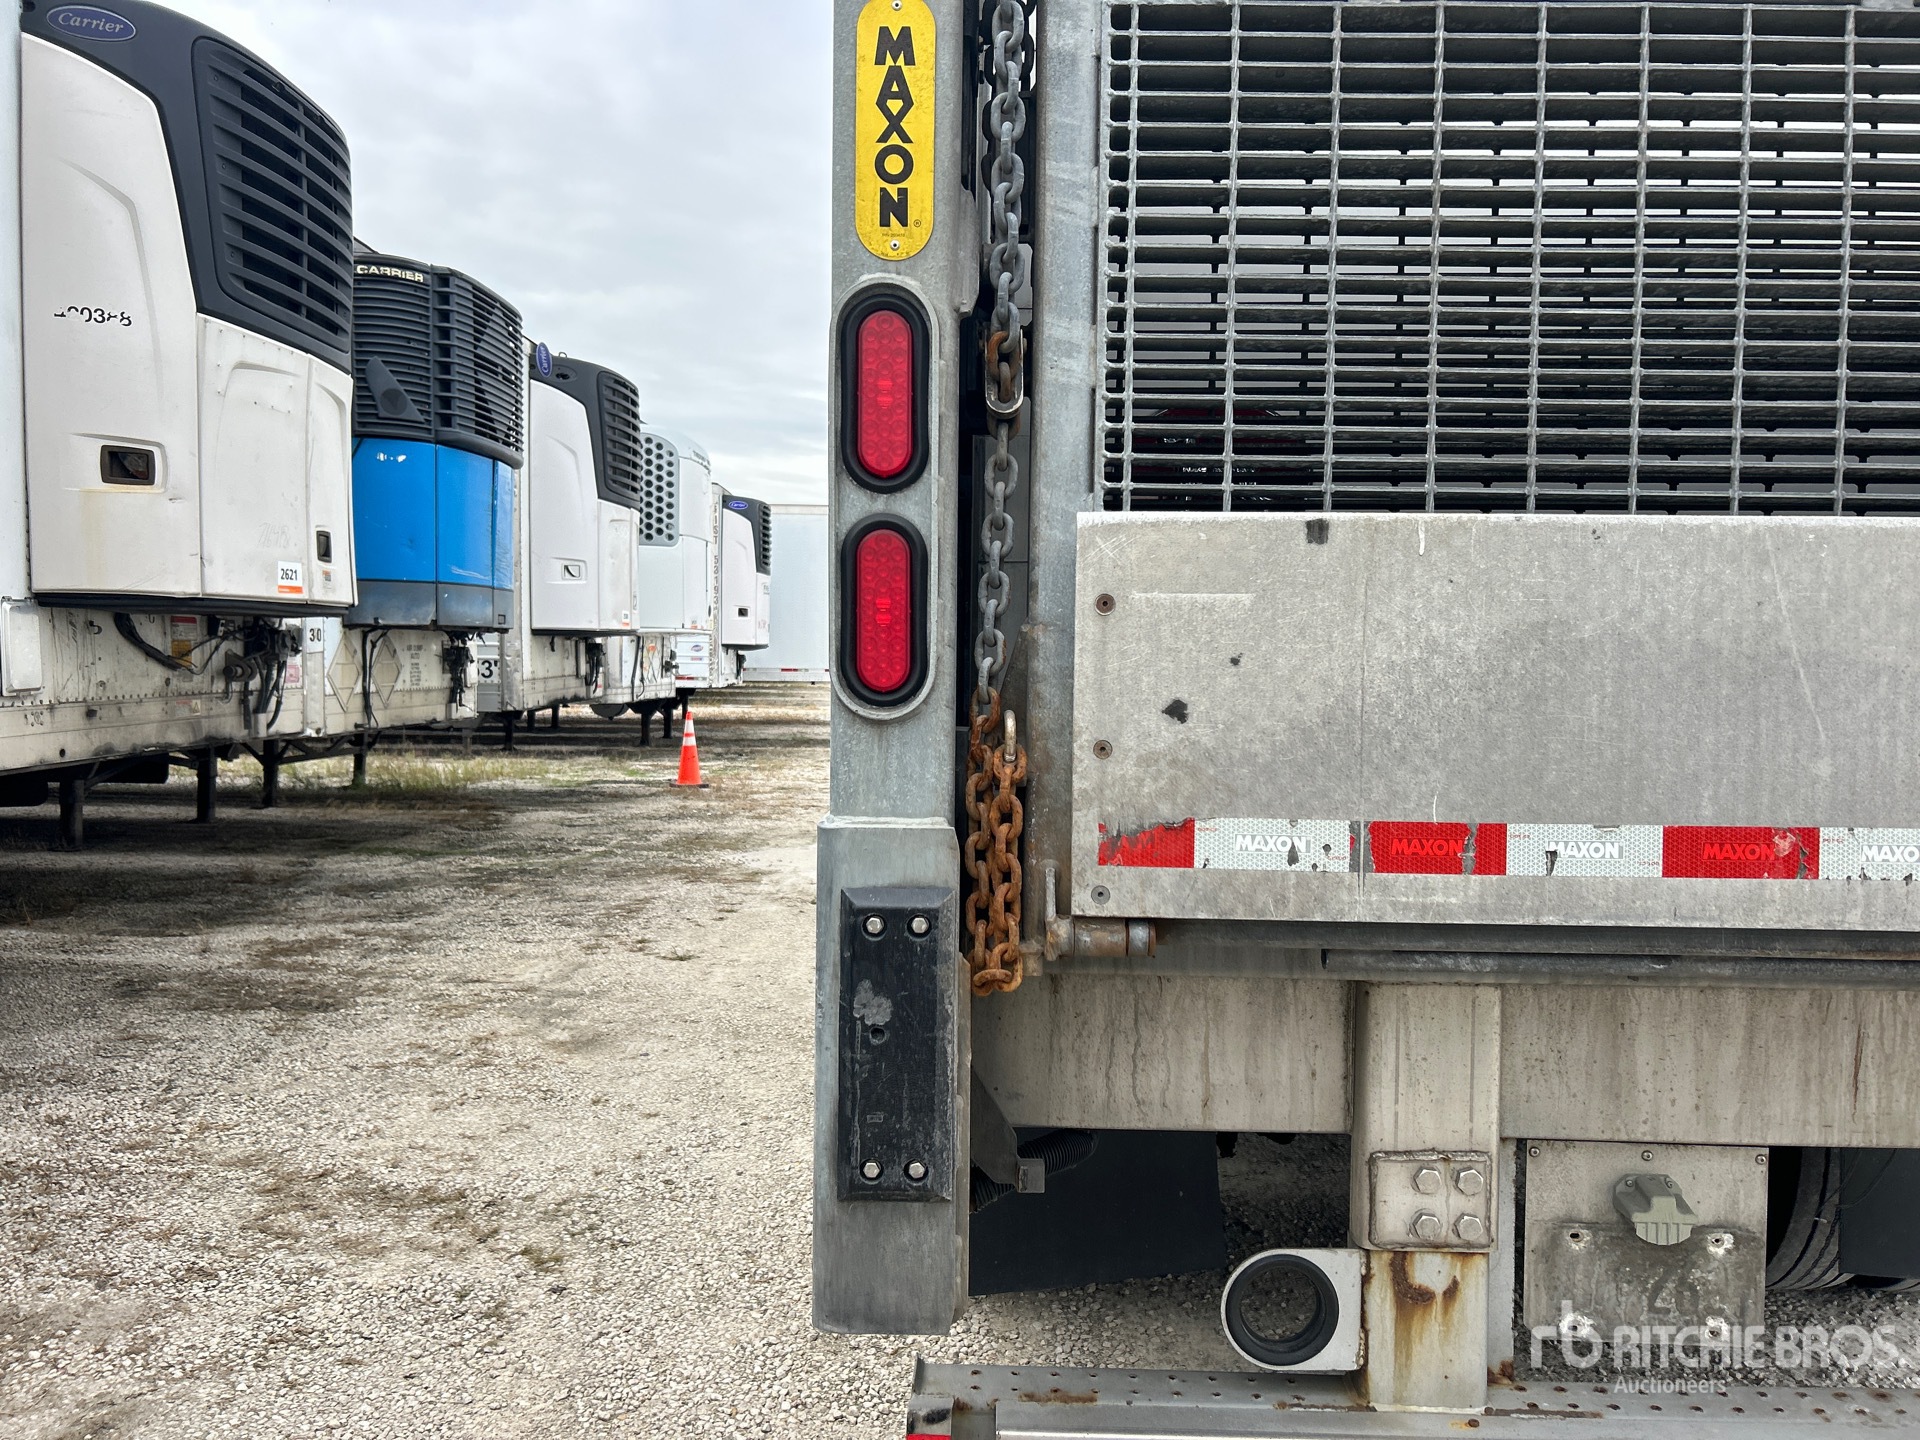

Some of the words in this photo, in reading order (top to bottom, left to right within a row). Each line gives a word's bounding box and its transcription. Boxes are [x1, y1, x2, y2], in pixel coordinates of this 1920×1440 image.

[58, 12, 124, 33] Carrier
[874, 26, 916, 228] MAXON
[356, 264, 424, 283] CARRIER
[280, 568, 298, 581] 2621
[309, 628, 322, 642] 30
[478, 659, 498, 679] 3'
[1235, 834, 1307, 852] MAXON
[1391, 838, 1464, 856] MAXON
[1546, 841, 1620, 859] MAXON
[1702, 843, 1776, 861] MAXON
